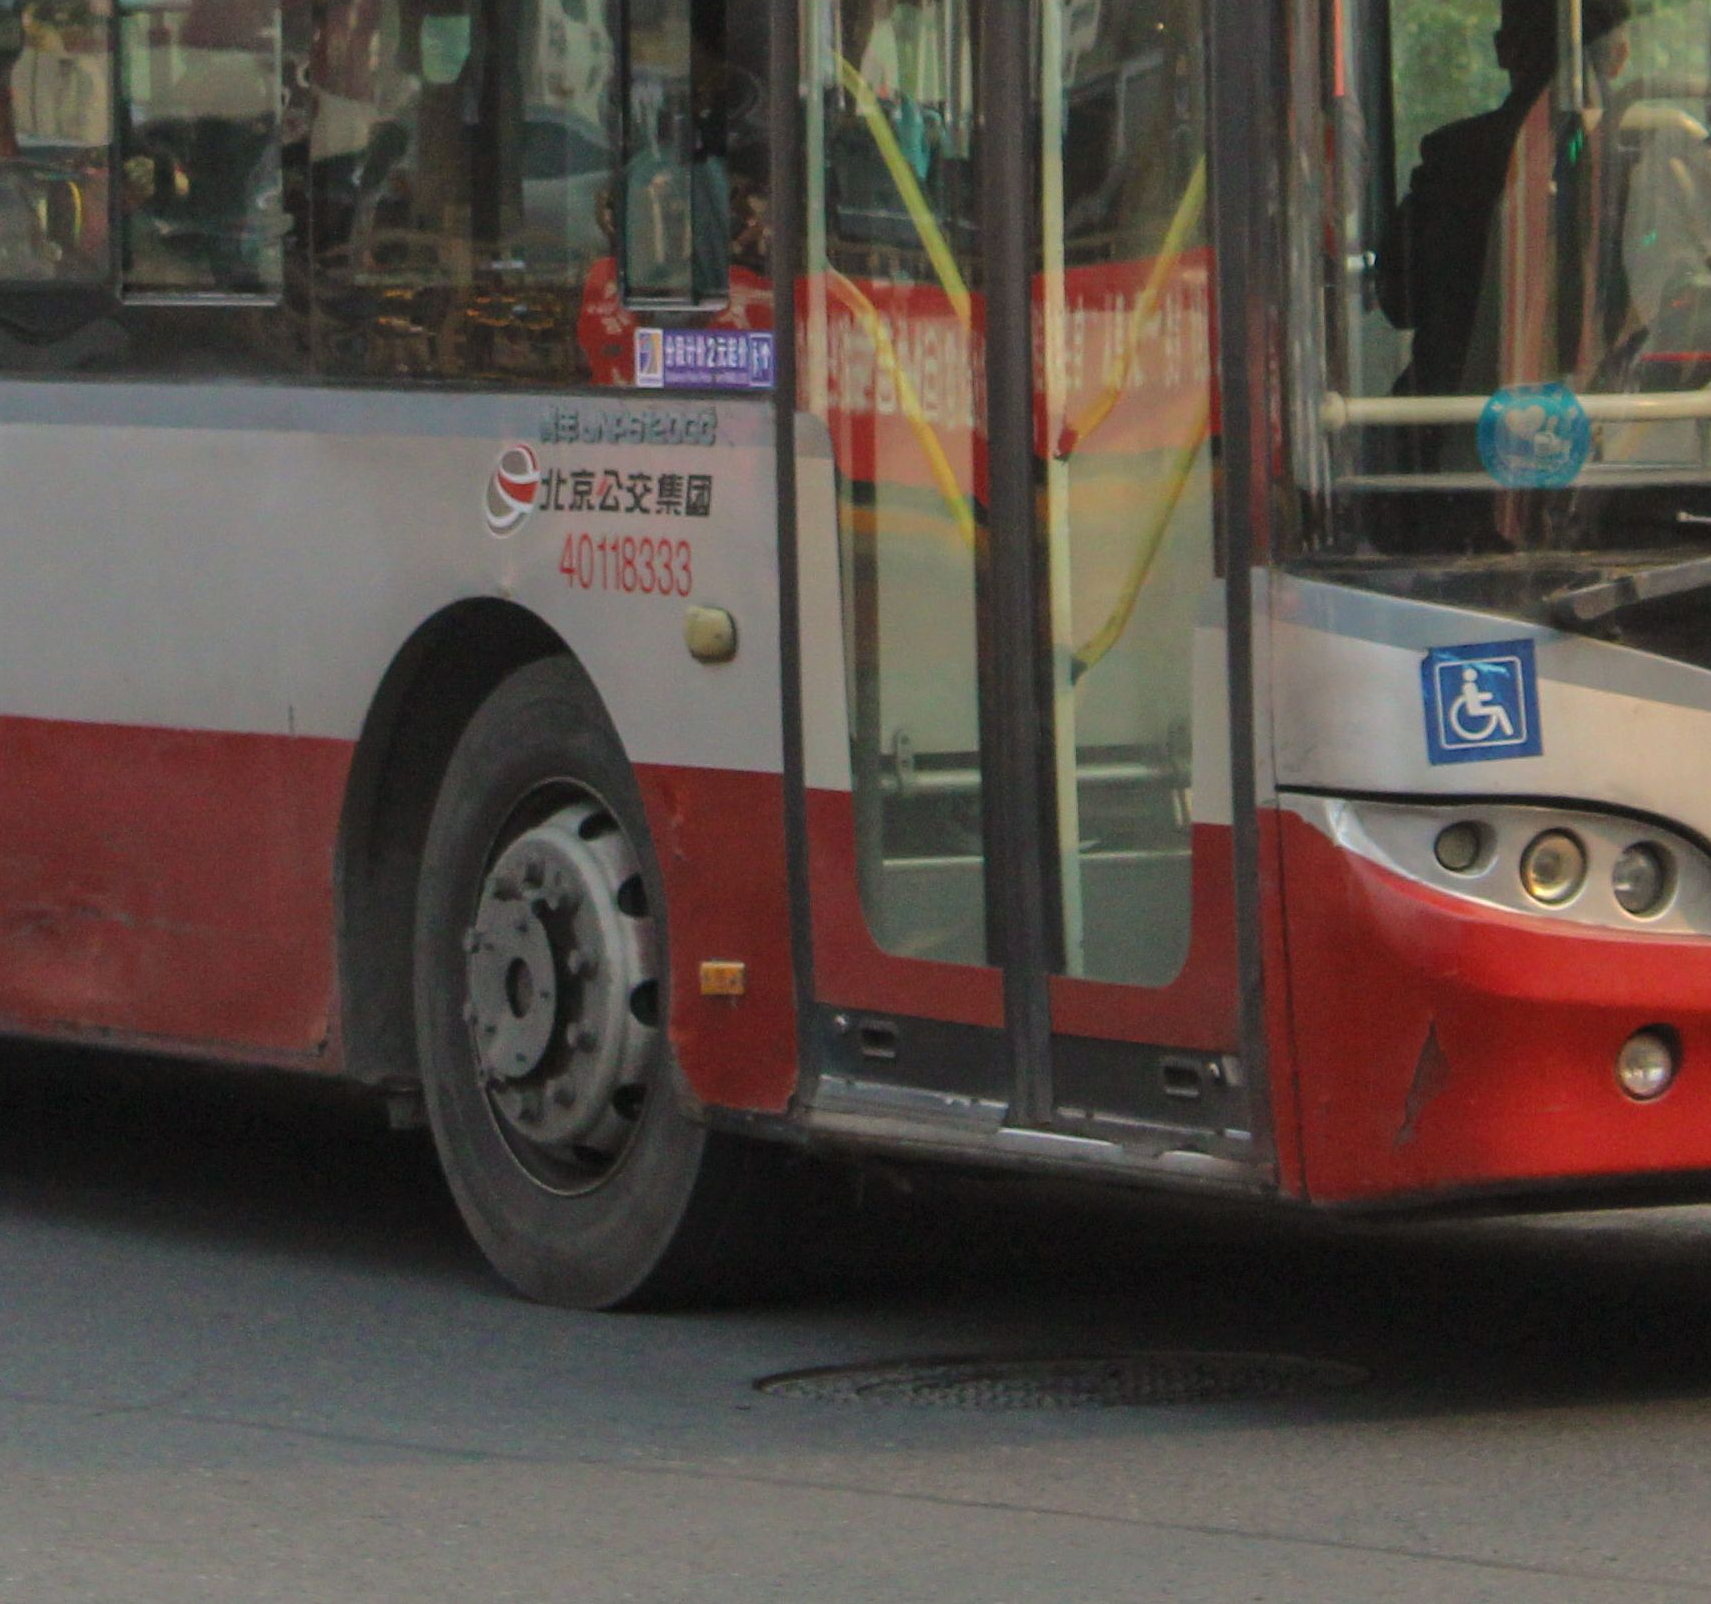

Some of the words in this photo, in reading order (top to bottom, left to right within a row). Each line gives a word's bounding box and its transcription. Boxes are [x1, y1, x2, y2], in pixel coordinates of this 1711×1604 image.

[540, 468, 712, 517] 北京公交集团
[559, 533, 692, 597] 40118333
